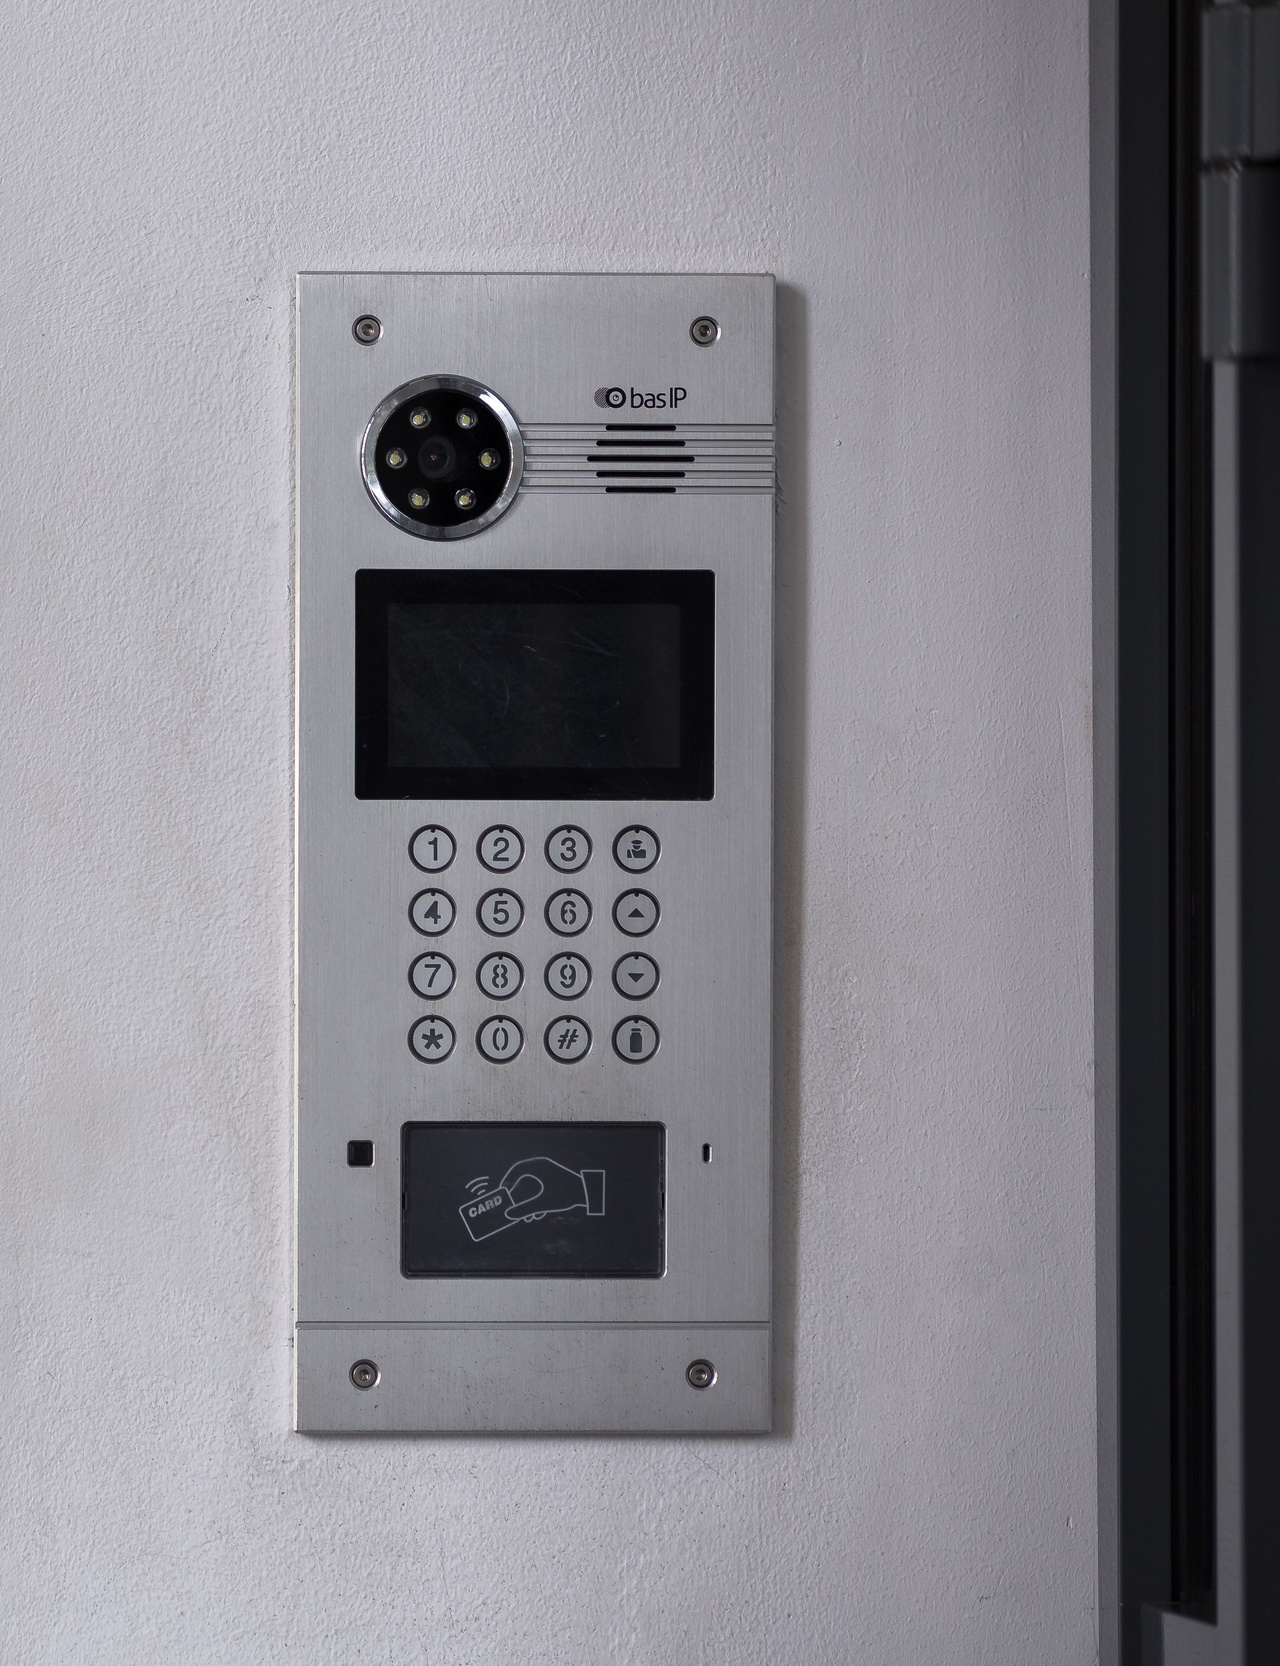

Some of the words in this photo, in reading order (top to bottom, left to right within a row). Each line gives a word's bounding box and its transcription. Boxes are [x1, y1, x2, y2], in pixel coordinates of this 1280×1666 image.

[427, 836, 438, 862] 1
[491, 836, 510, 862] 2
[559, 836, 577, 863] 3
[423, 900, 442, 925] 4
[492, 900, 510, 926] 5
[559, 900, 577, 926] 6
[423, 963, 442, 988] 7
[491, 963, 509, 989] 8
[559, 963, 577, 989] 9
[491, 1026, 509, 1052] 0
[468, 1195, 503, 1218] CARD
